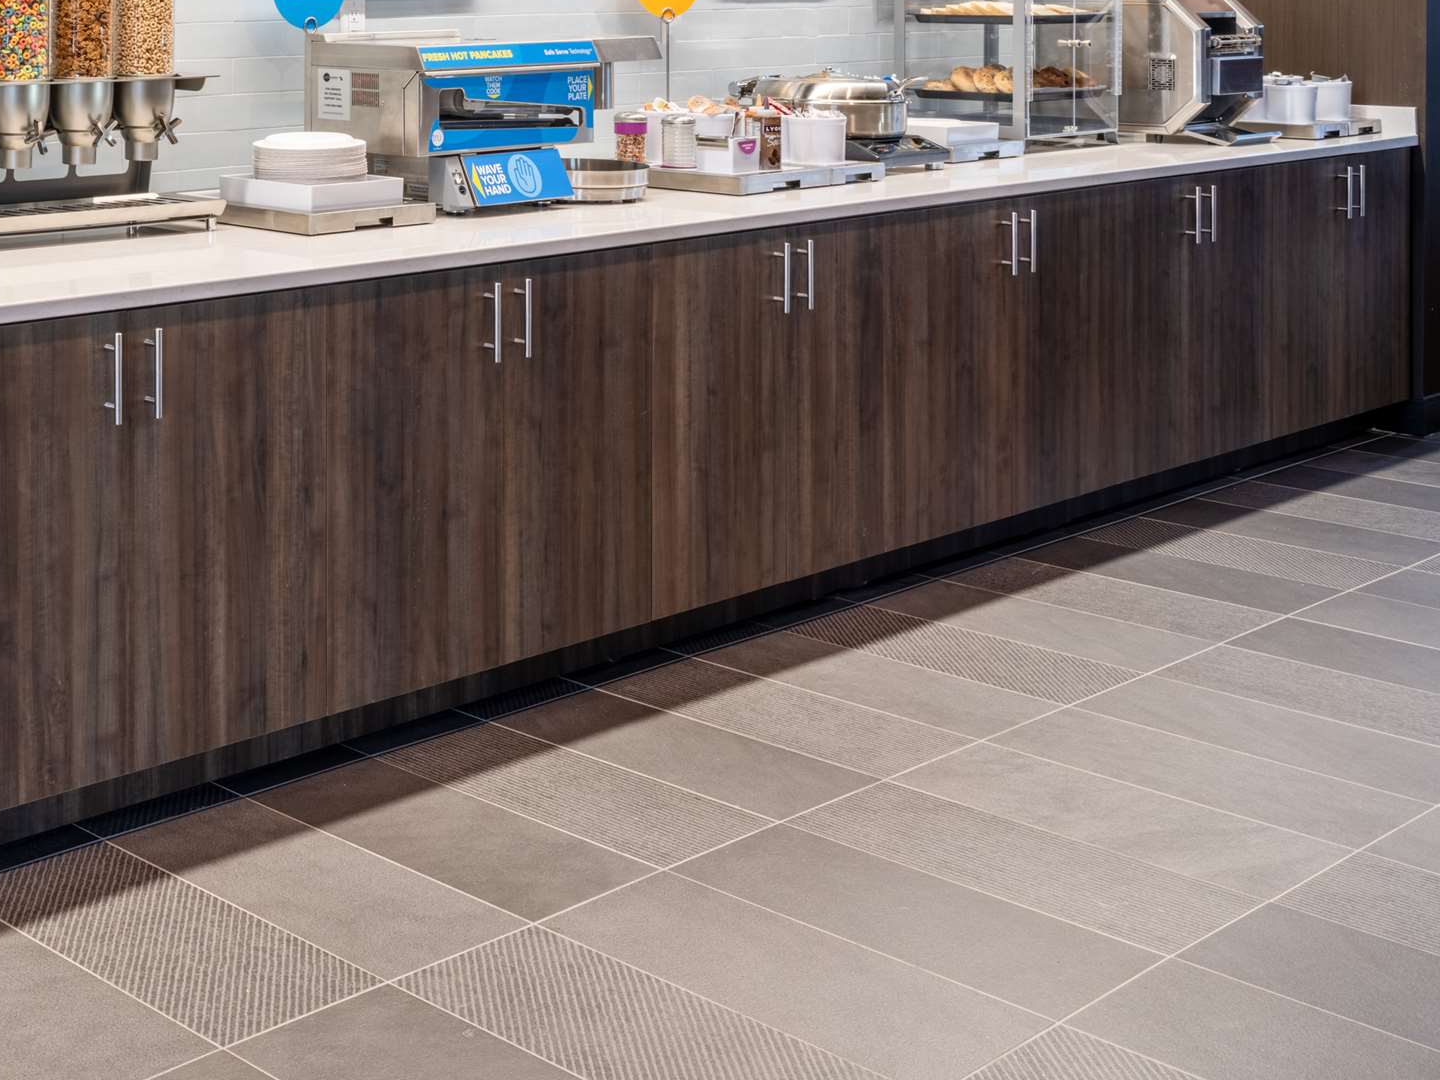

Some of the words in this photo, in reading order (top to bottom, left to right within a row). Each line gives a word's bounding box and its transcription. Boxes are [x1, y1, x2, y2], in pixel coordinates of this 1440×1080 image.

[422, 52, 449, 63] FRESH
[451, 51, 468, 61] HOT
[470, 49, 513, 60] PANCAKES
[567, 75, 588, 84] PLACE
[568, 84, 586, 92] YOUR
[567, 92, 587, 101] PLATE
[476, 164, 504, 175] WAVE
[480, 174, 508, 186] YOUR
[485, 185, 512, 196] HAND
